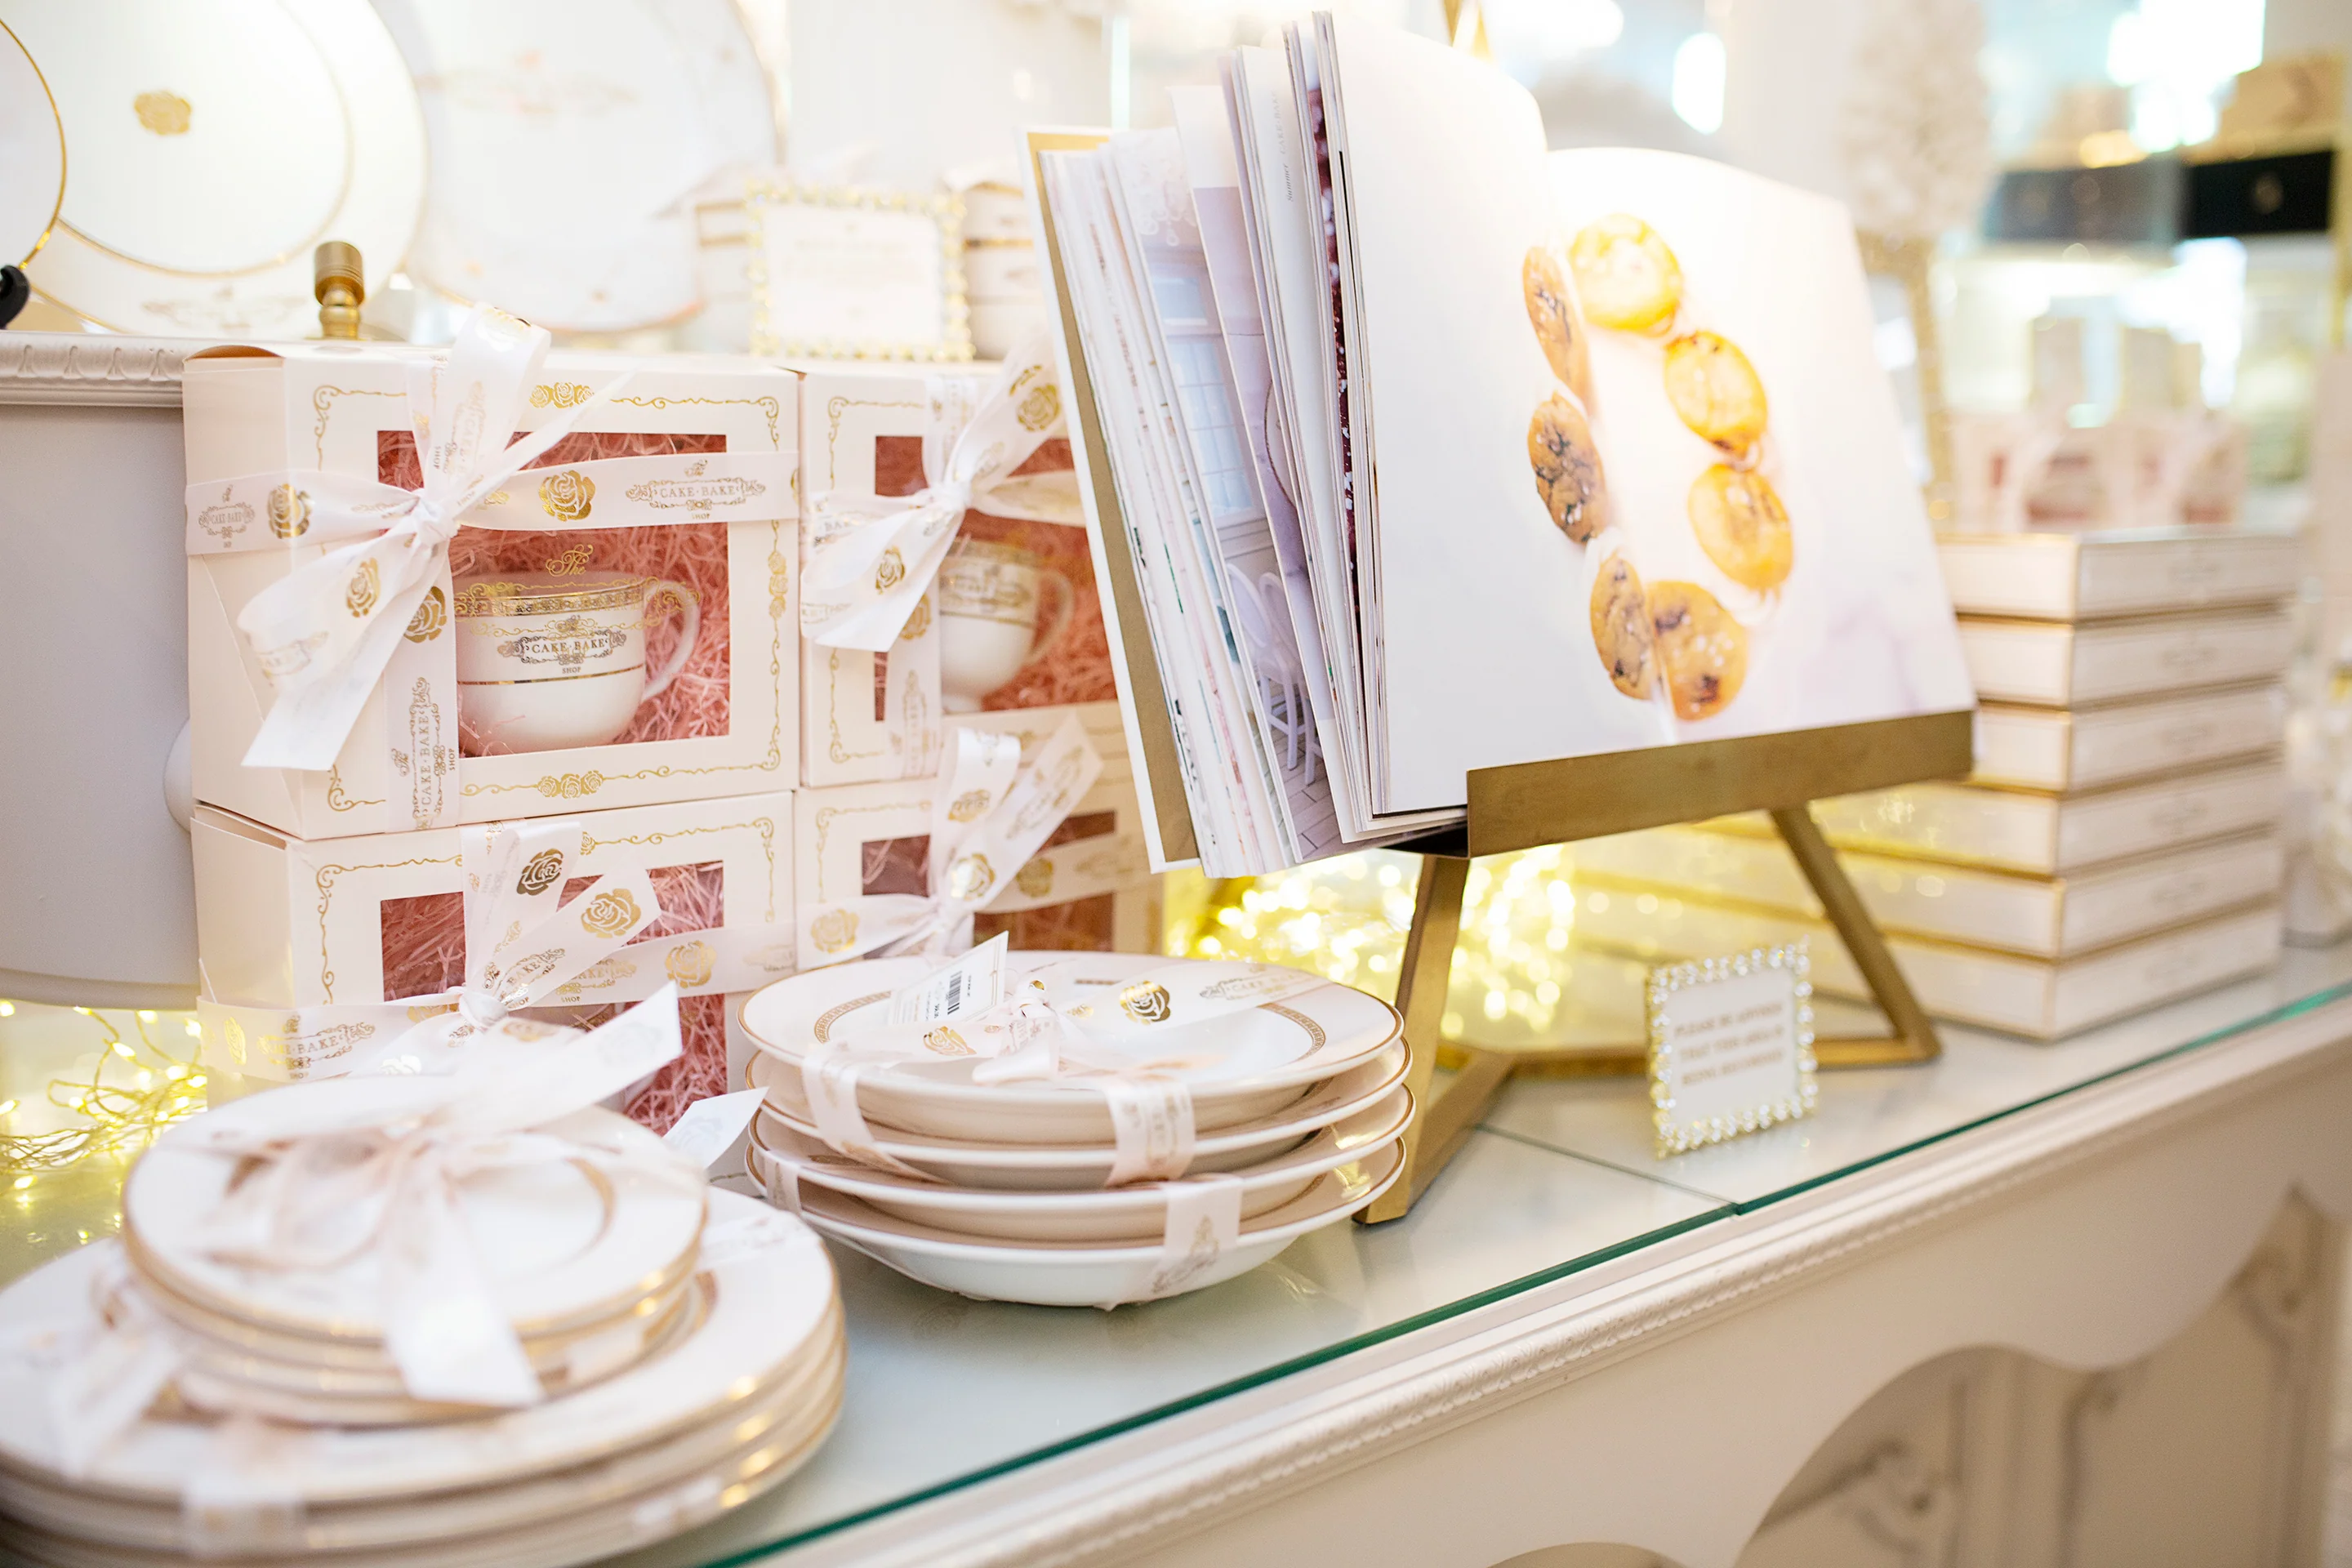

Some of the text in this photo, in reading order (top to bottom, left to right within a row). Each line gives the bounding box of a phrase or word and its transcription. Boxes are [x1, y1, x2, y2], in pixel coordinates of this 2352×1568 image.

[660, 485, 737, 498] CAKE BAKE
[545, 543, 594, 577] The
[532, 642, 567, 654] CAKE
[573, 639, 605, 651] BAKE
[419, 715, 432, 806] CAKE BAKE
[506, 962, 541, 986] BAKE
[297, 1036, 339, 1054] BAKE
